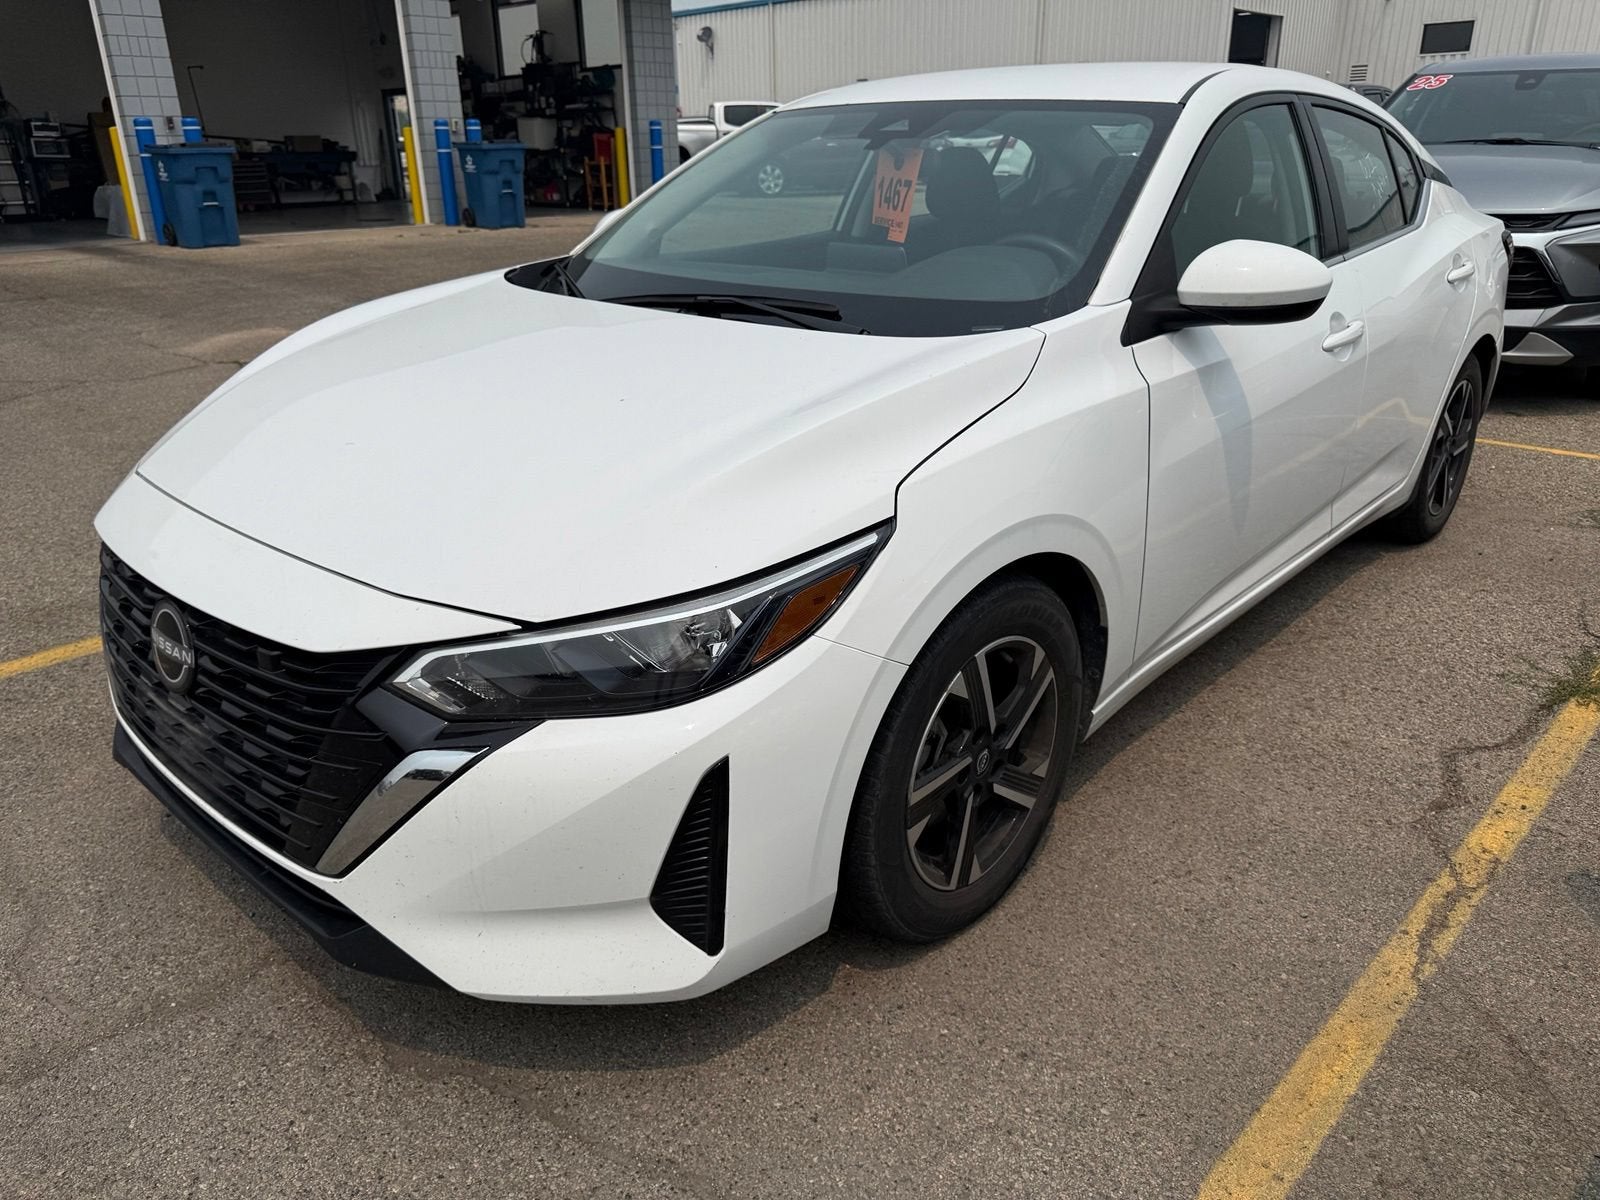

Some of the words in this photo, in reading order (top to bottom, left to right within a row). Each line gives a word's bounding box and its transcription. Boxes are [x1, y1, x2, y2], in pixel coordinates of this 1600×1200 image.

[1406, 74, 1454, 91] 25
[878, 176, 912, 213] 1467
[151, 627, 192, 665] NISSAN
